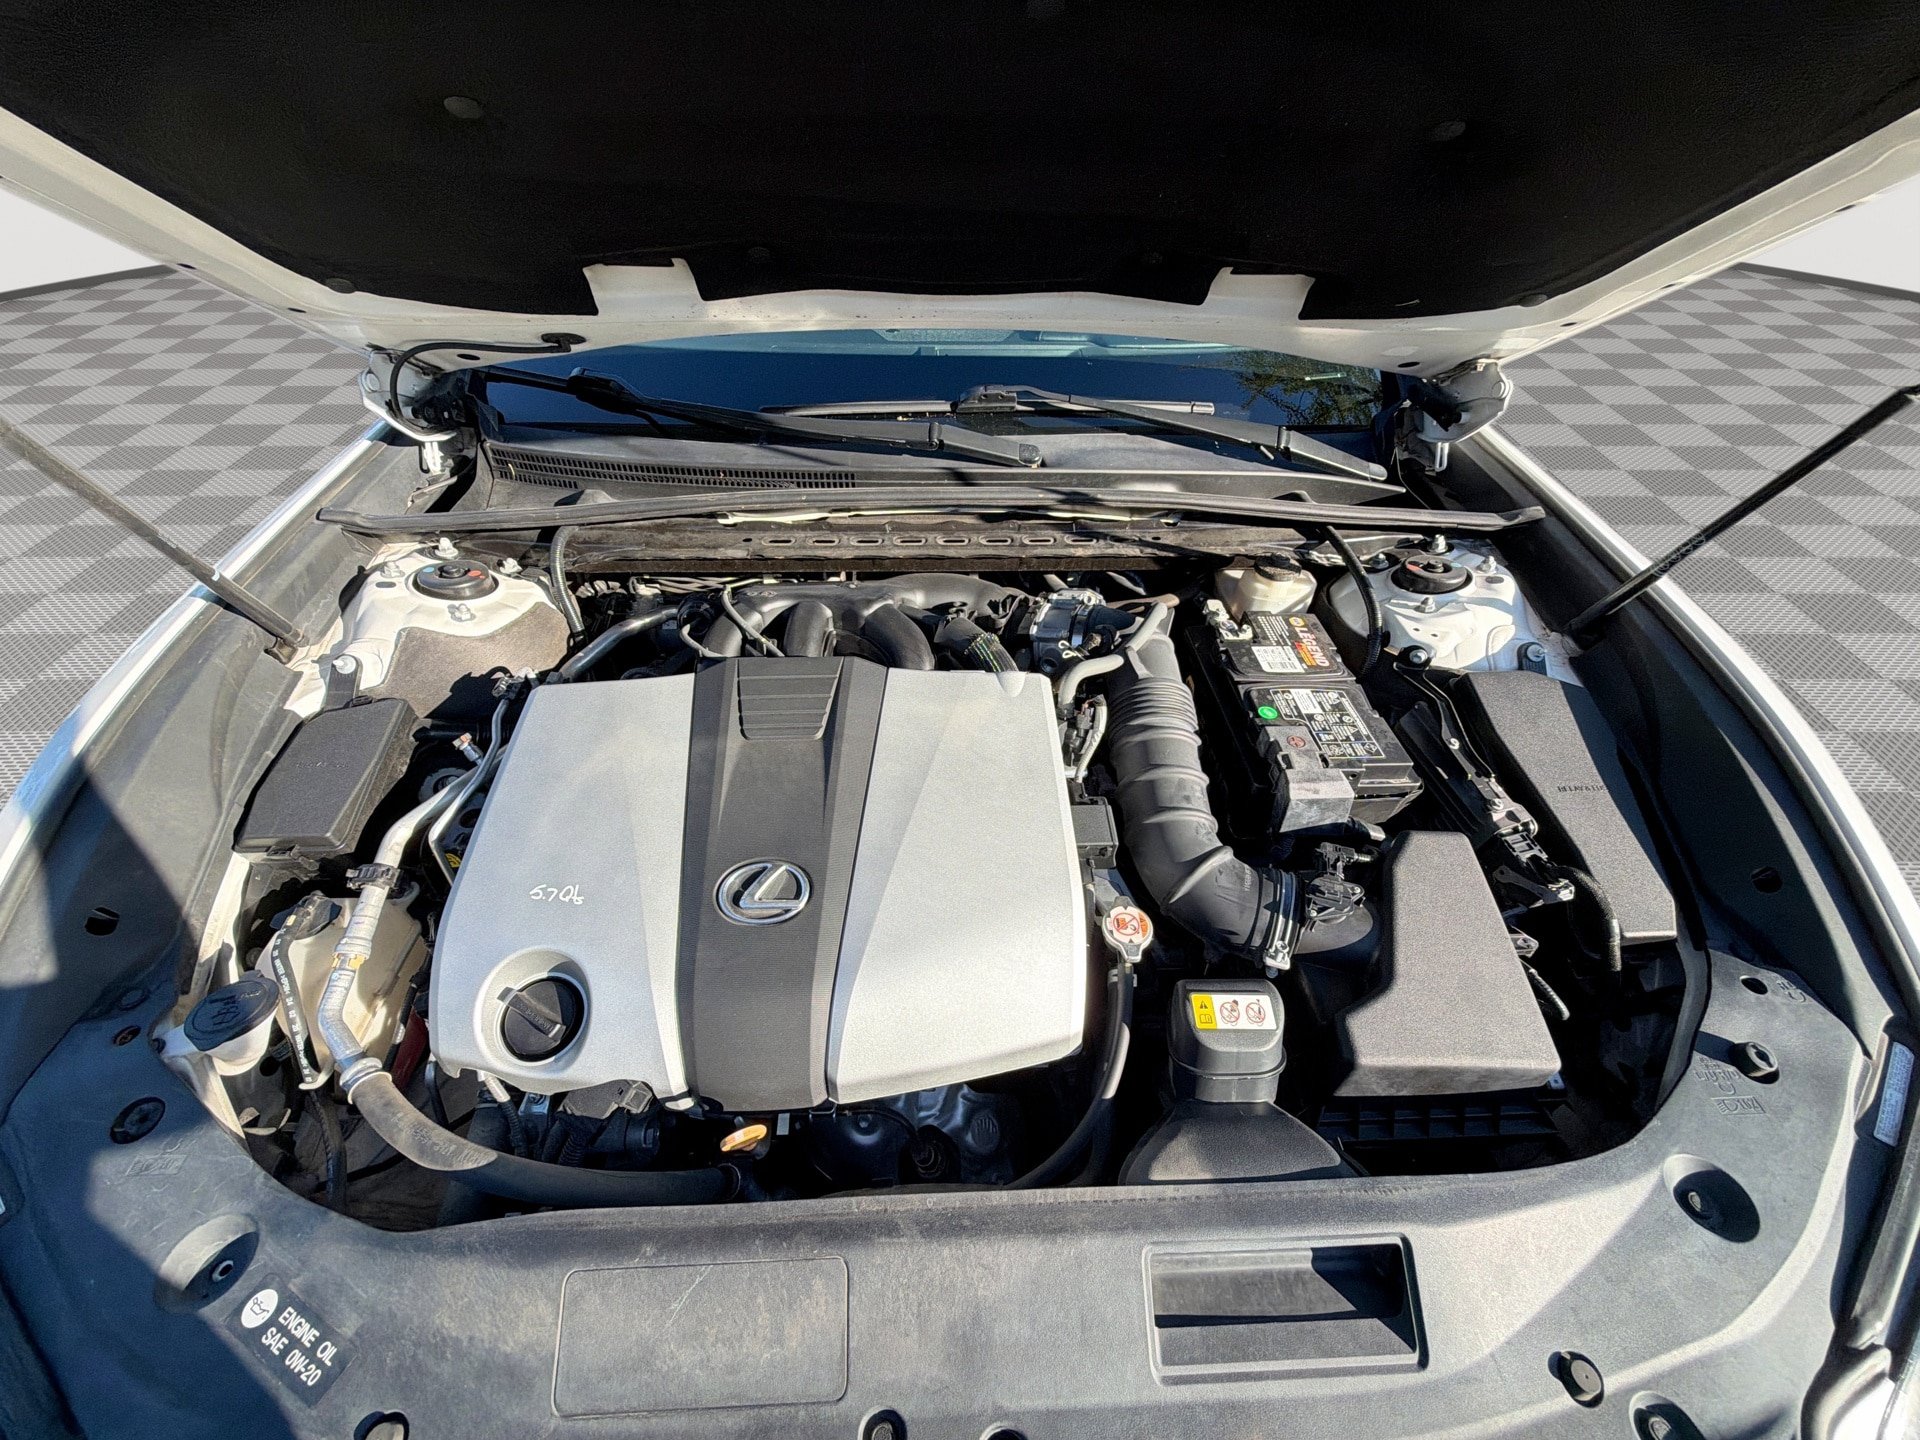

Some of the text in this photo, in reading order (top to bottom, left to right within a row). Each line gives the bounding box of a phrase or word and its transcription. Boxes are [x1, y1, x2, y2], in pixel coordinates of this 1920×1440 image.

[529, 884, 559, 902] 5.7
[261, 1326, 322, 1387] SAE 0W-20
[278, 1306, 338, 1367] ENGINE OIL
